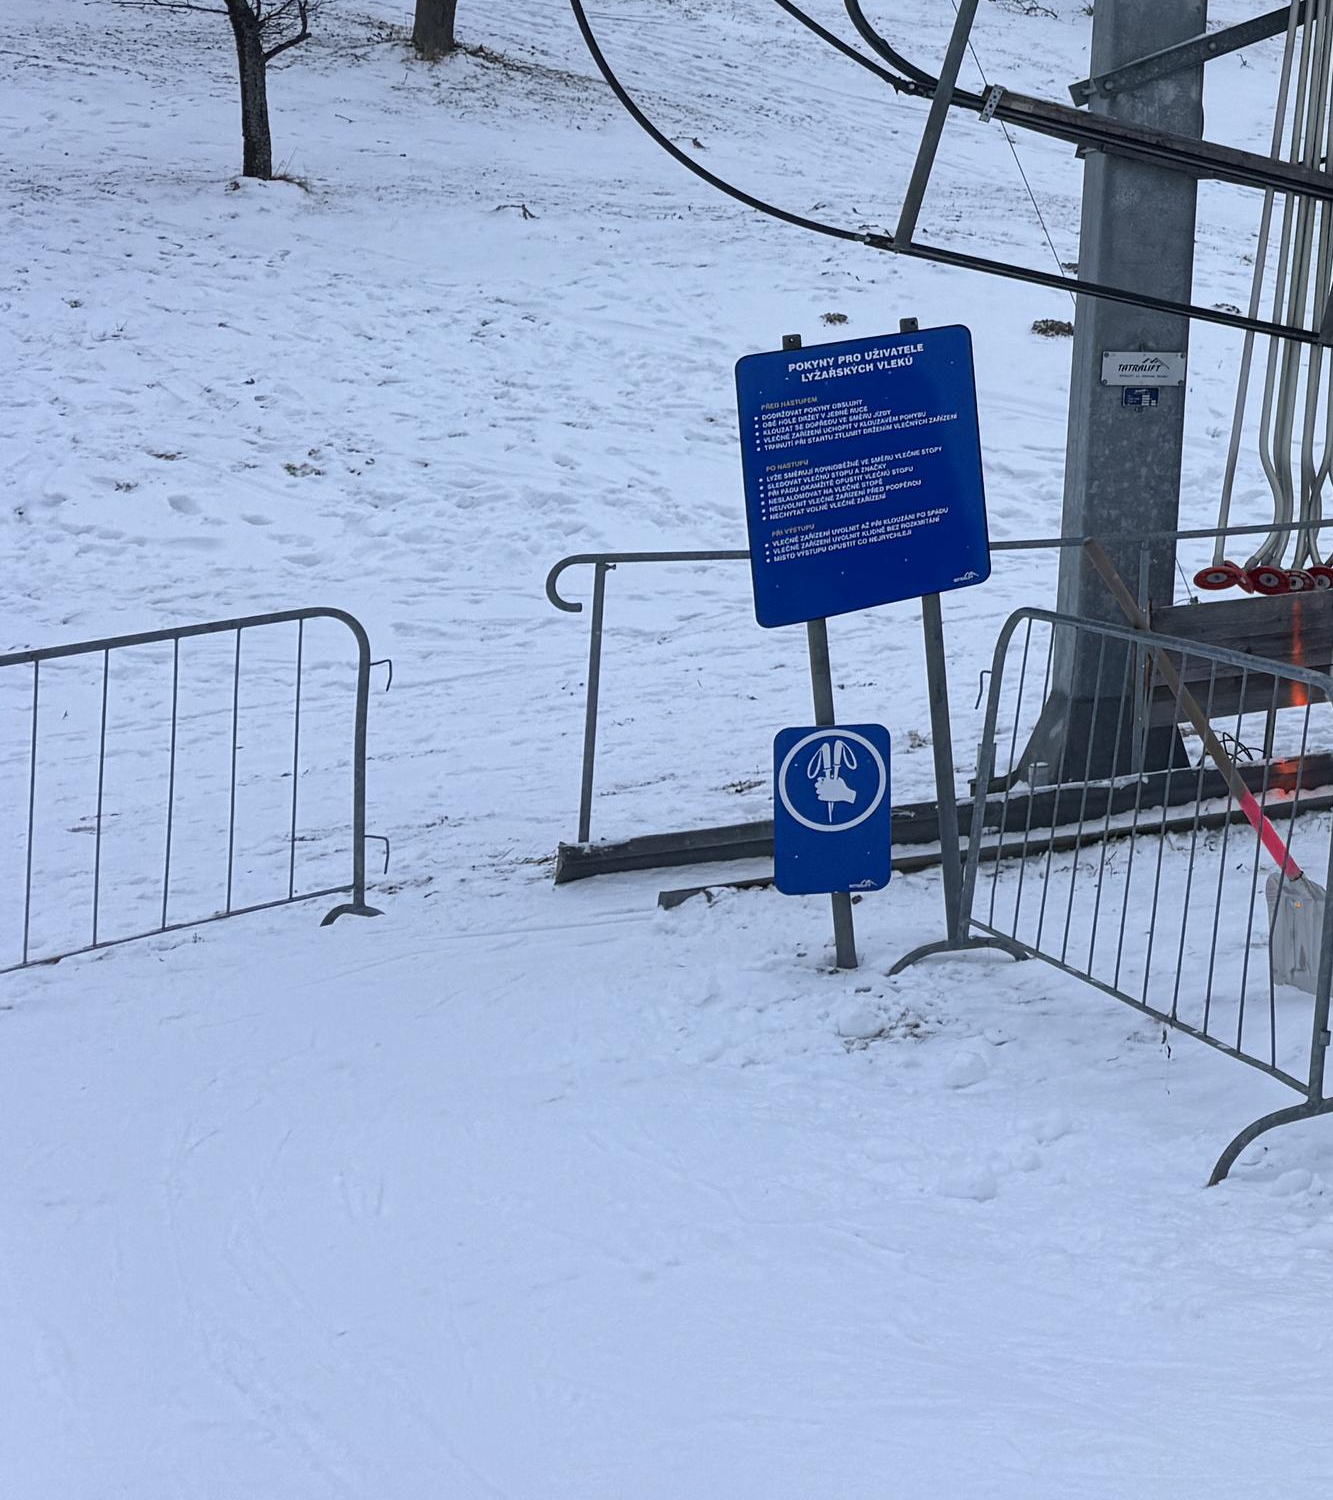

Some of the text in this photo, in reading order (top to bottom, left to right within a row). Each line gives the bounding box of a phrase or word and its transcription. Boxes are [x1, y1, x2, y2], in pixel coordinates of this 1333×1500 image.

[788, 343, 924, 373] POKYNY PRO UŽIVATELE
[801, 355, 913, 383] LYŽAŘSKÝCH VLEKŮ
